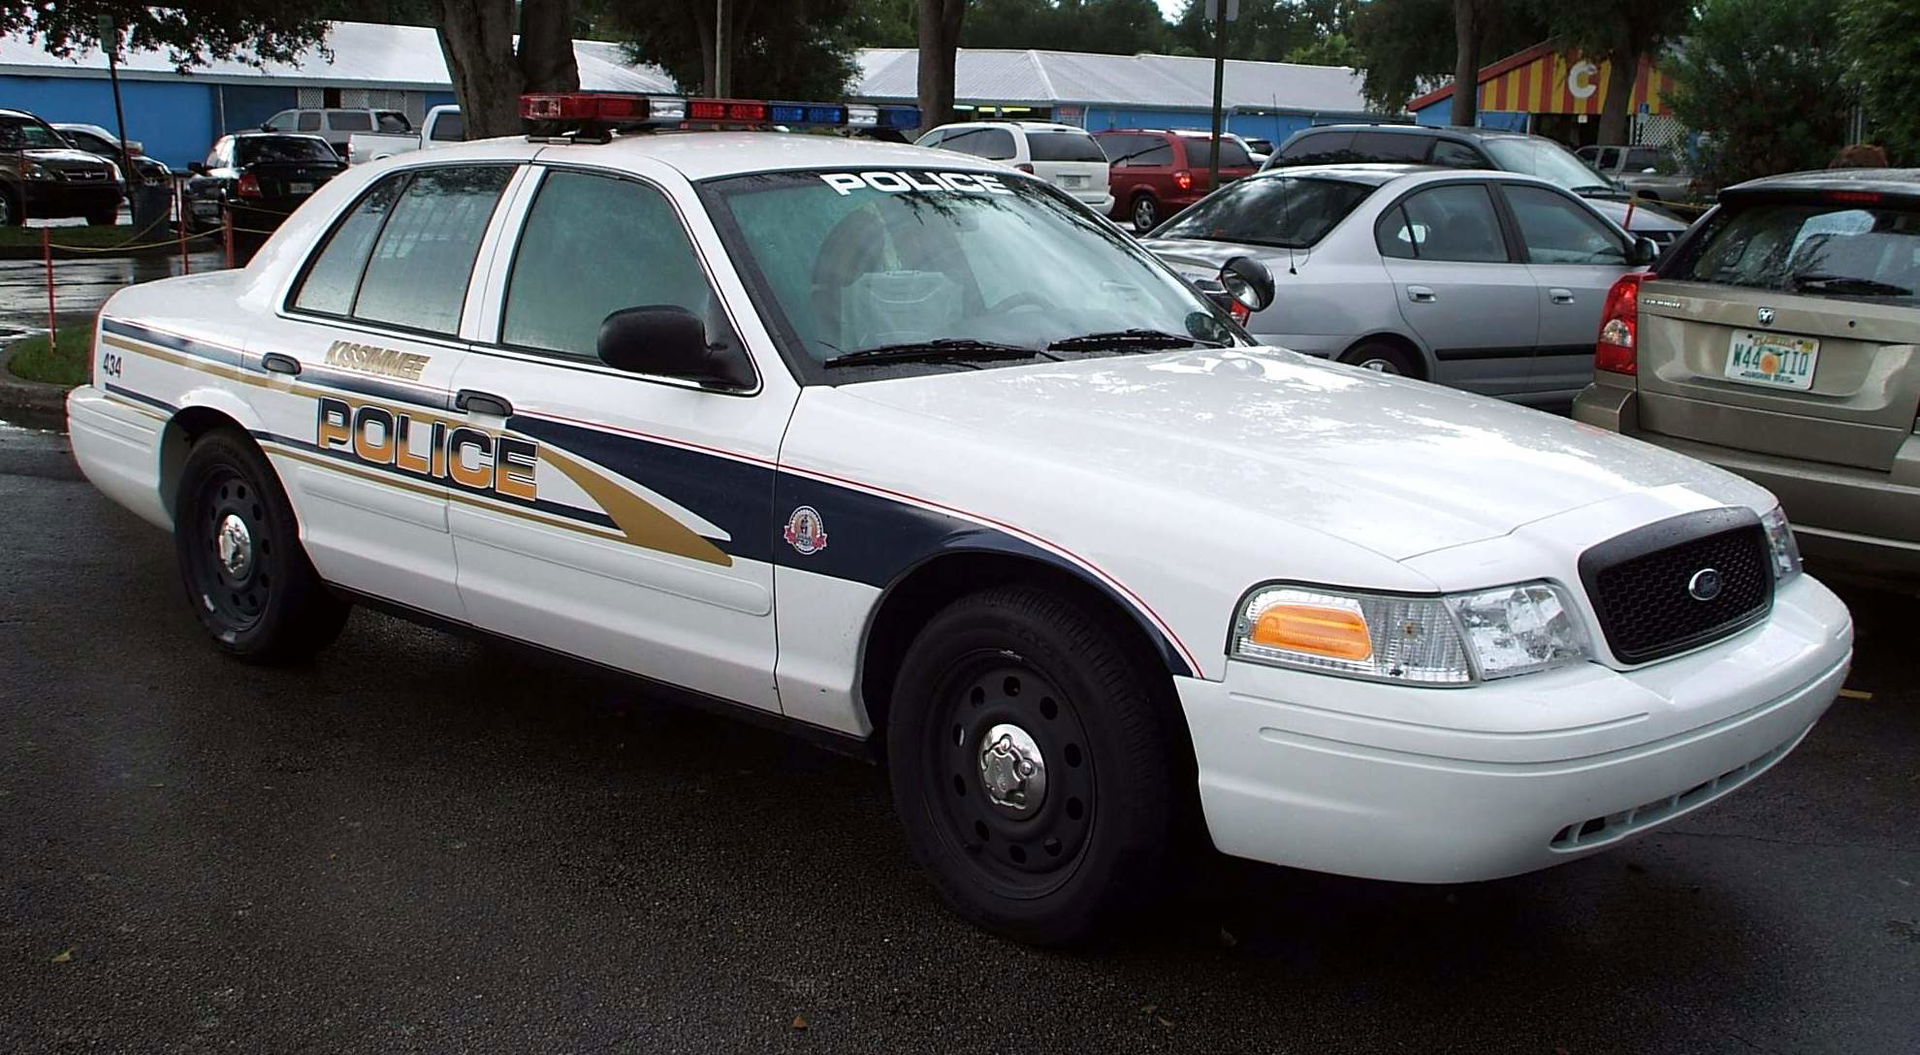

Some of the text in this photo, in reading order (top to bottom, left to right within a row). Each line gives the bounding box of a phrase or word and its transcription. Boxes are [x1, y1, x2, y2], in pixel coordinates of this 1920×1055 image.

[1568, 60, 1598, 98] C
[819, 171, 1015, 196] POLICE
[103, 352, 122, 378] 434
[324, 339, 431, 381] KISSIMMEE
[1732, 343, 1761, 370] W44
[317, 395, 539, 502] POLICE
